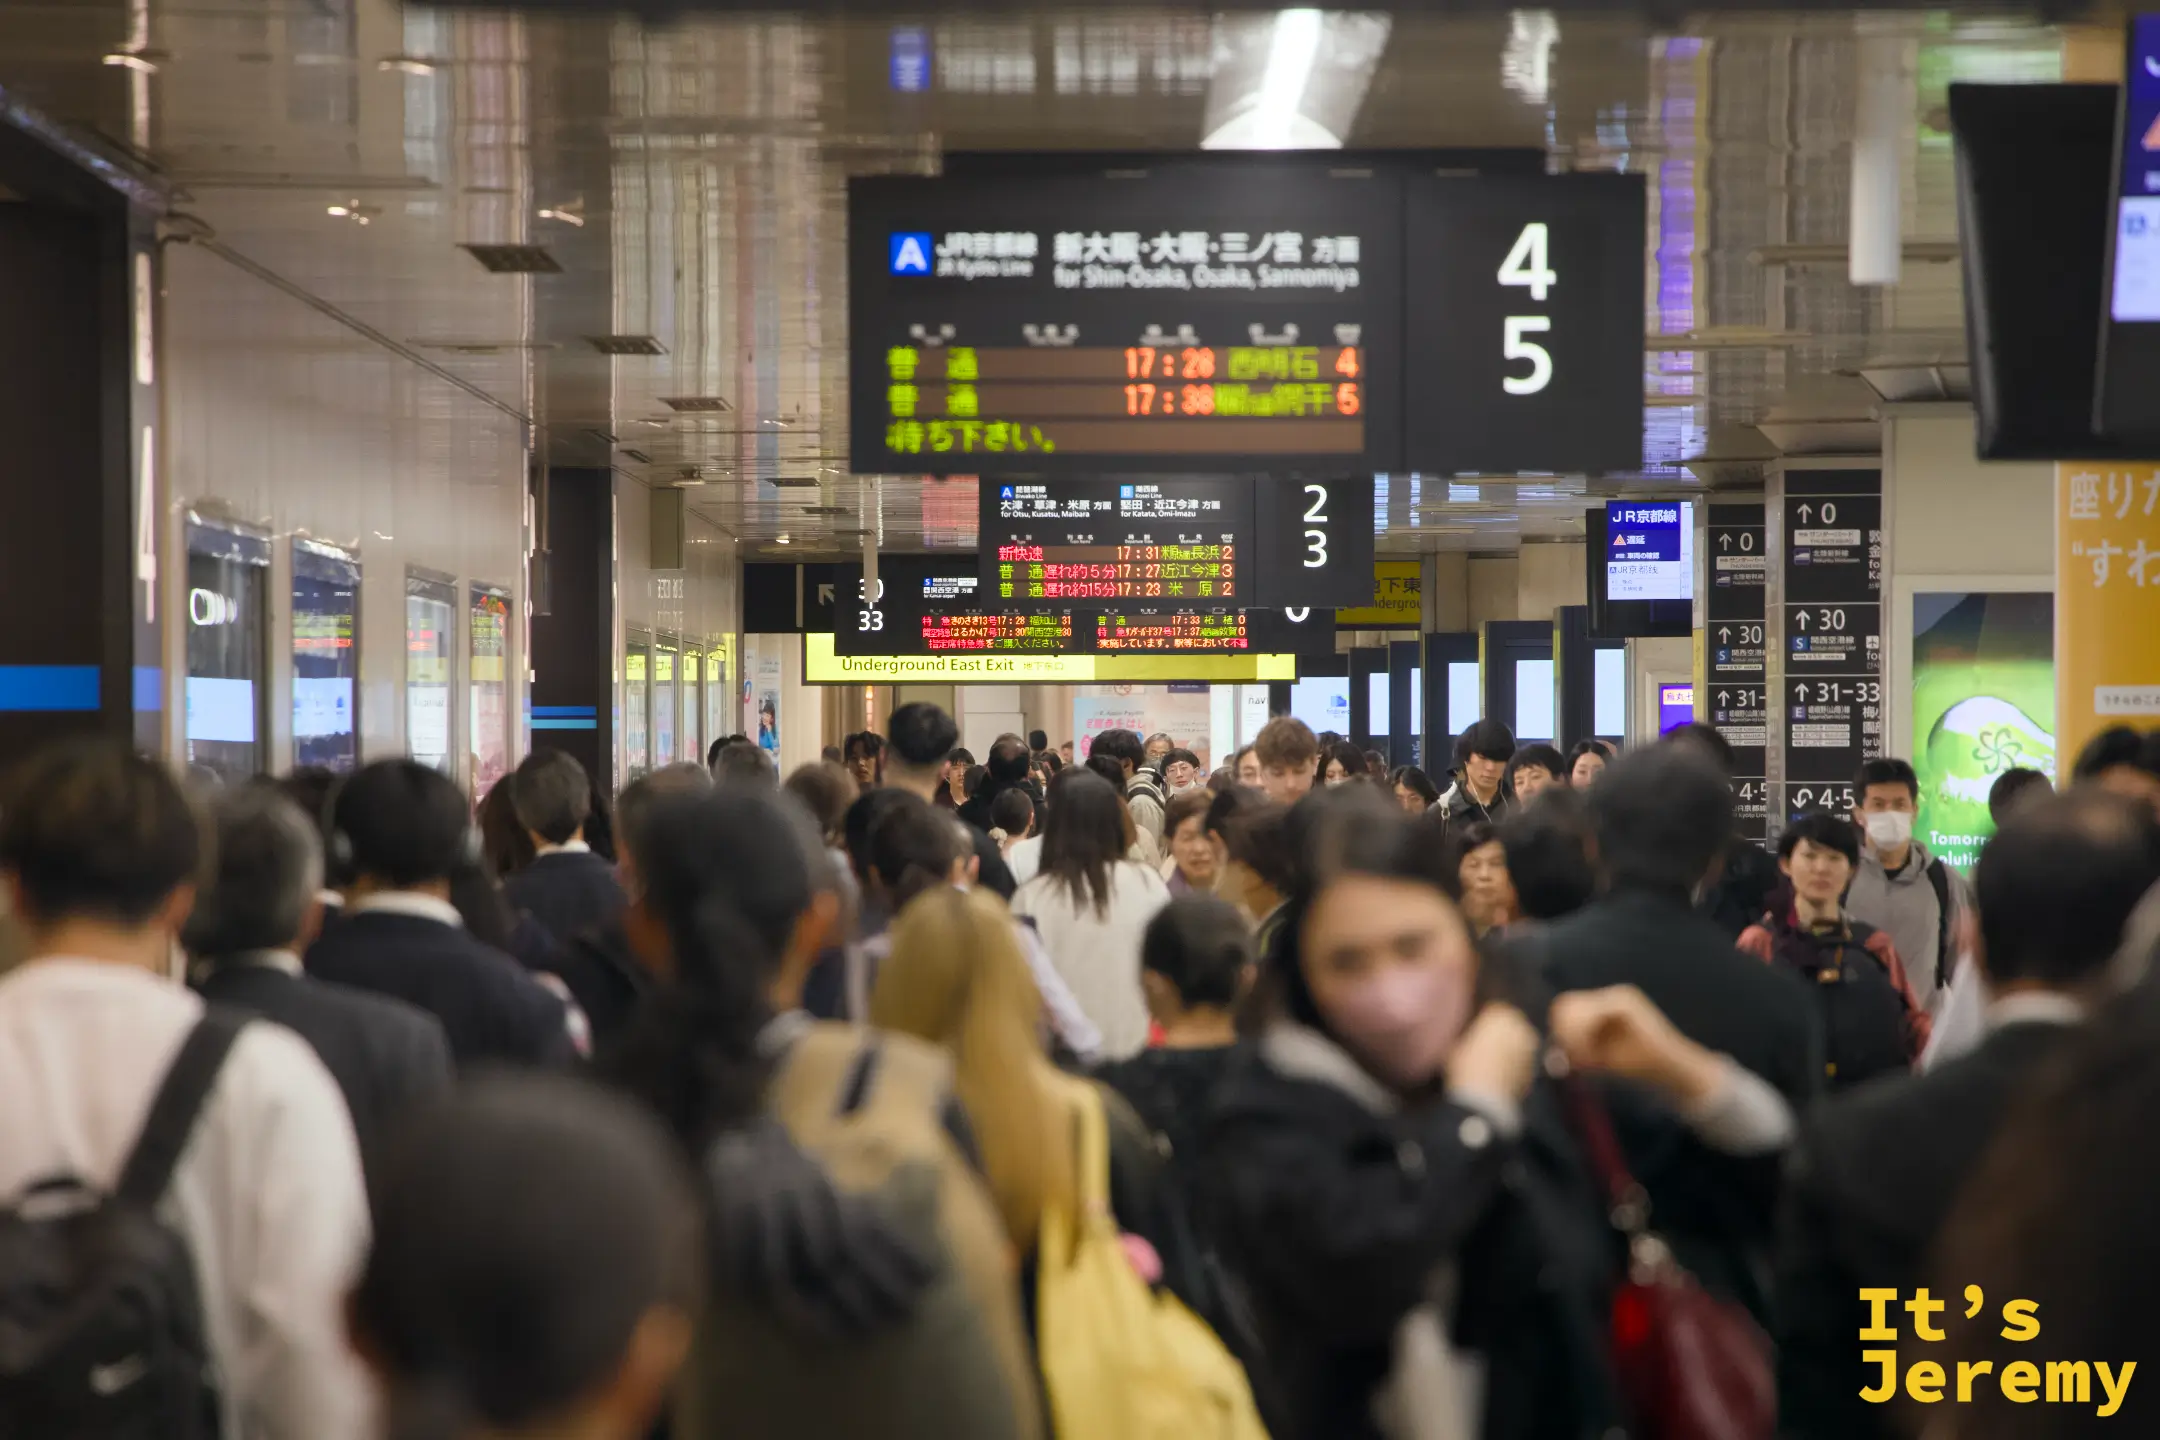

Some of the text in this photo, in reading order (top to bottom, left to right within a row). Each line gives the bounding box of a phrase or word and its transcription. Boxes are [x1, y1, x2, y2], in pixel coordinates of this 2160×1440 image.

[894, 236, 928, 271] A
[1497, 222, 1558, 301] 4
[1335, 347, 1359, 378] 4
[1502, 315, 1553, 395] 5
[1303, 484, 1328, 522] 2
[1001, 510, 1011, 518] for
[1061, 510, 1090, 518] Maibara
[1120, 510, 1131, 518] for
[1132, 510, 1157, 519] Katata,
[1821, 503, 1836, 524] 0
[1303, 530, 1328, 568] 3
[1740, 532, 1753, 551] 0
[999, 545, 1043, 561] 新快速
[1117, 546, 1159, 560] 17:31
[1222, 546, 1233, 560] 2
[999, 563, 1232, 579] 普通 遅れ約5分 17:27 近江今津 3
[999, 581, 1232, 597] 普通 遅れ約15分 17:23 米原 2
[858, 611, 883, 631] 33
[997, 616, 1025, 626] 17:28
[1062, 616, 1071, 625] 31
[1171, 616, 1200, 625] 17:33
[1238, 616, 1246, 625] 0
[1819, 609, 1845, 630] 30
[997, 628, 1025, 637] 17:30
[1062, 628, 1072, 637] 30
[1238, 627, 1246, 636] 0
[1739, 626, 1762, 644] 30
[1796, 637, 1803, 649] S
[1719, 650, 1726, 661] S
[842, 658, 1014, 674] Underground East Exit
[1817, 683, 1880, 702] 31-33
[1718, 711, 1724, 720] E
[1795, 706, 1802, 718] E
[1930, 830, 1992, 846] Tomorr
